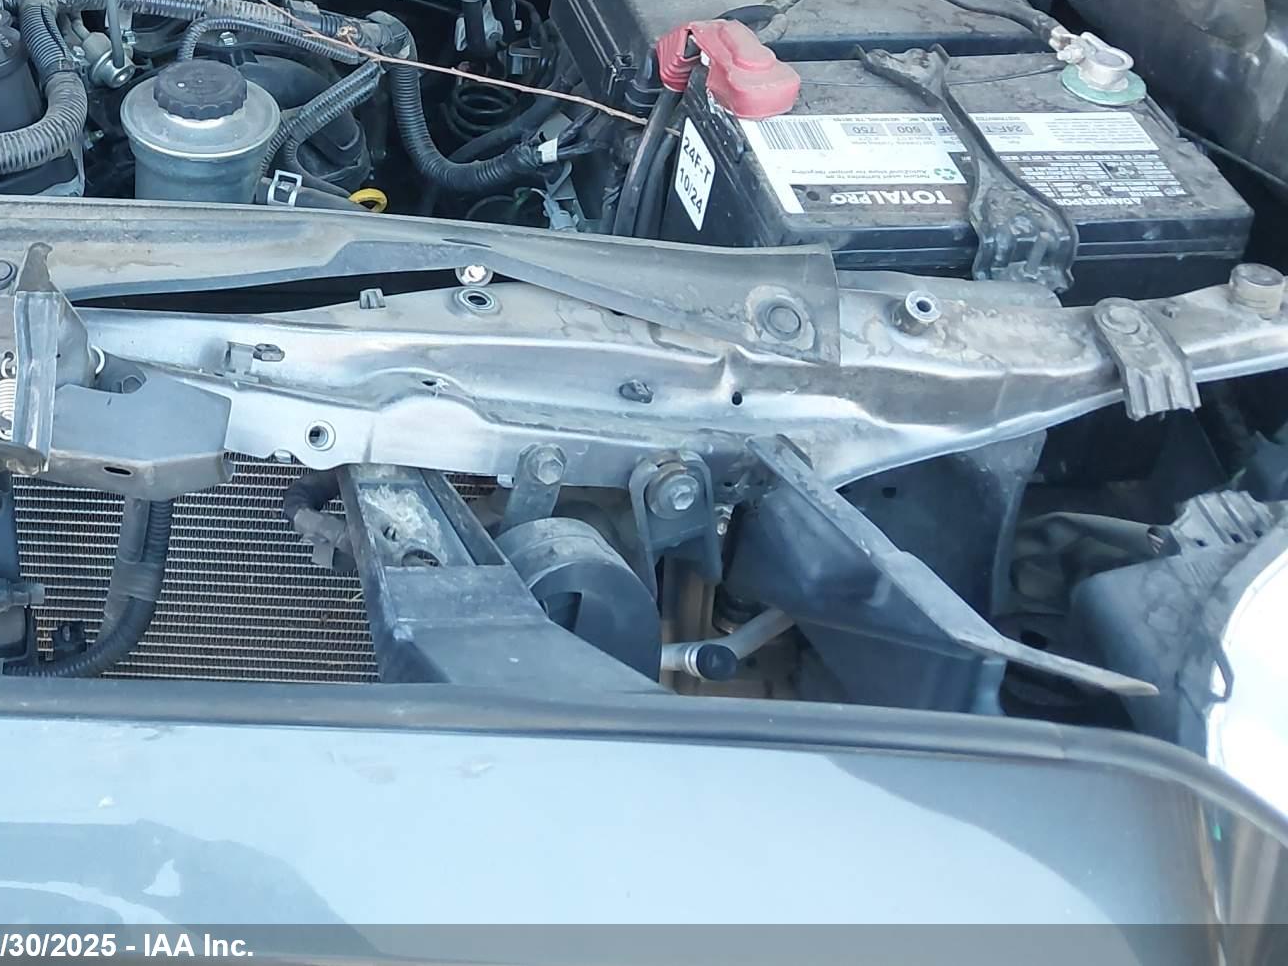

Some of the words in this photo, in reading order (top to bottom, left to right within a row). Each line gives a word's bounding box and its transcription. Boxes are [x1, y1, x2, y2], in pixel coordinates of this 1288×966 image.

[852, 125, 877, 134] 750
[683, 136, 711, 184] 24F-T
[679, 167, 703, 214] 10/24
[830, 190, 953, 205] TOTALPRO
